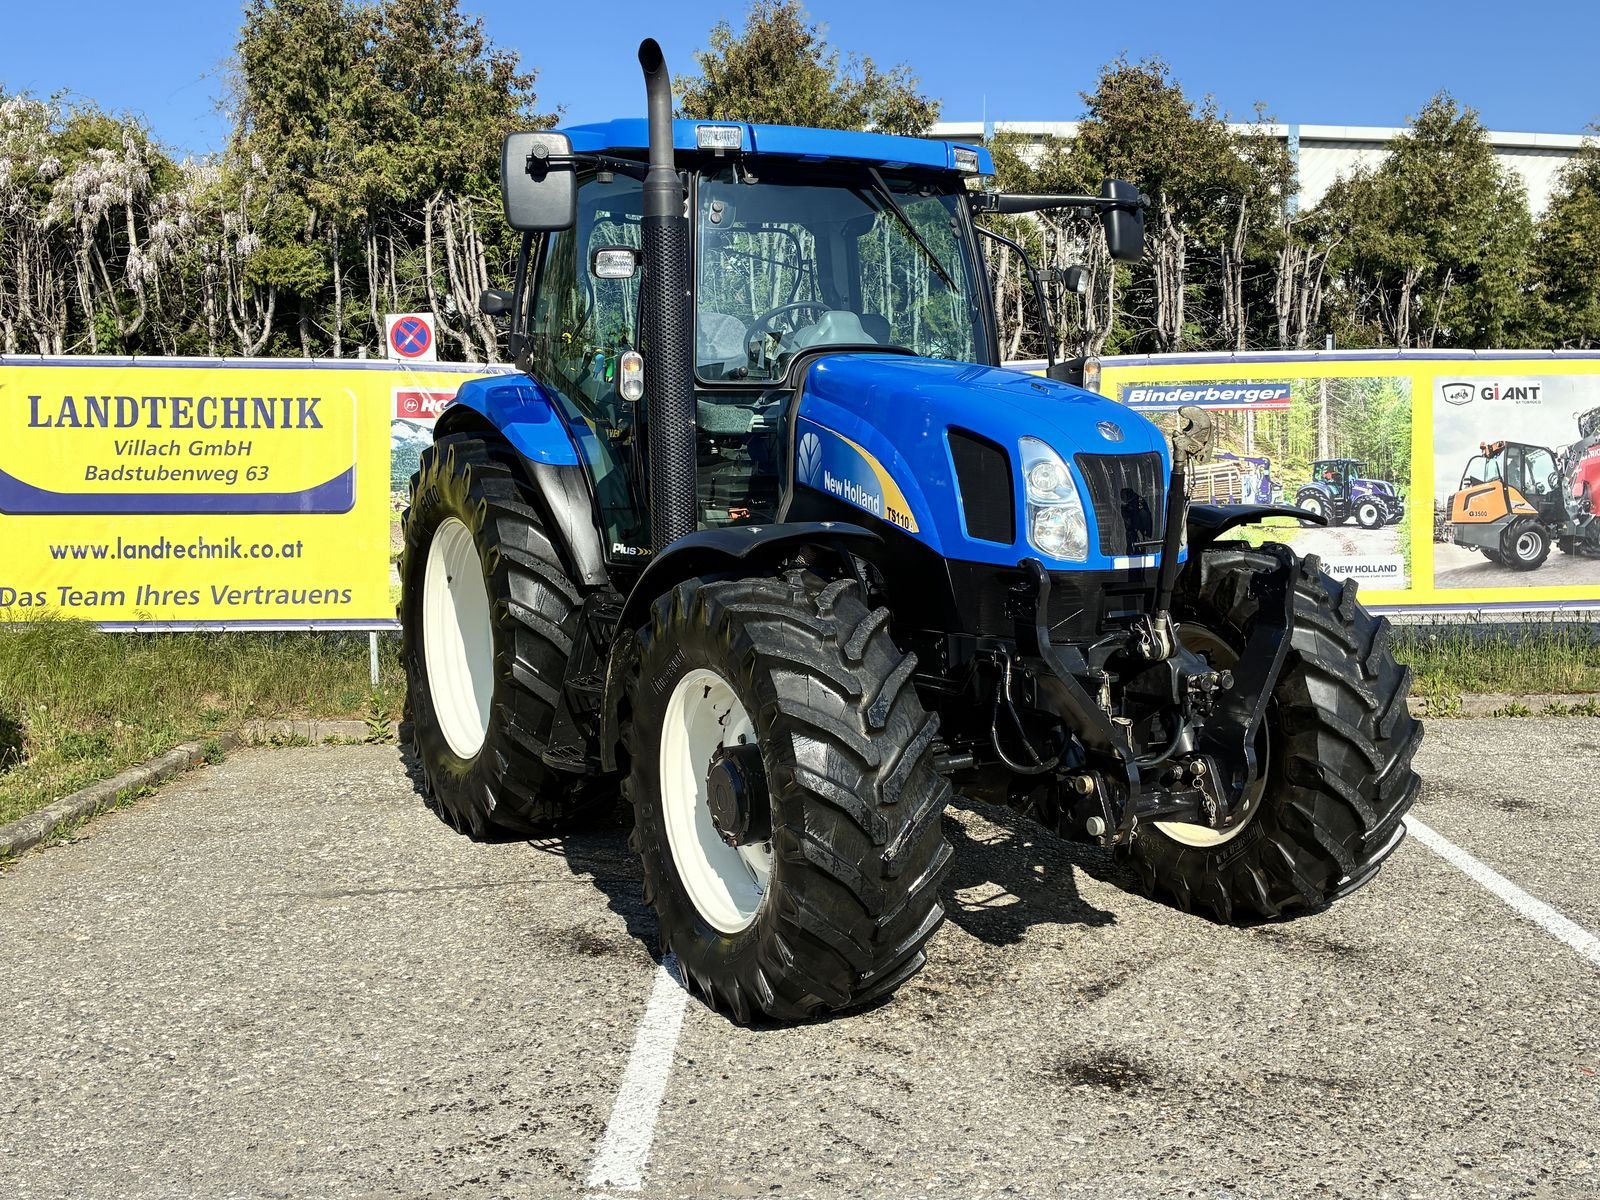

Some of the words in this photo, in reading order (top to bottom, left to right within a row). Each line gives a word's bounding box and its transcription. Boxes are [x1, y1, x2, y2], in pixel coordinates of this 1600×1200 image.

[1128, 388, 1287, 403] Binderberger
[28, 396, 323, 429] LANDTECHNIK
[115, 440, 180, 455] Villach
[189, 440, 251, 455] GmbH
[85, 465, 238, 485] Badstubenweg
[246, 466, 270, 482] 63
[824, 470, 843, 496] New
[844, 478, 880, 514] Holland
[50, 536, 303, 559] www.landtechnik.co.at
[1333, 565, 1354, 574] NEW
[1354, 564, 1397, 573] HOLLAND
[0, 586, 47, 607] Das
[58, 587, 124, 606] Team
[136, 585, 199, 605] Ihres
[211, 586, 351, 605] Vertrauens
